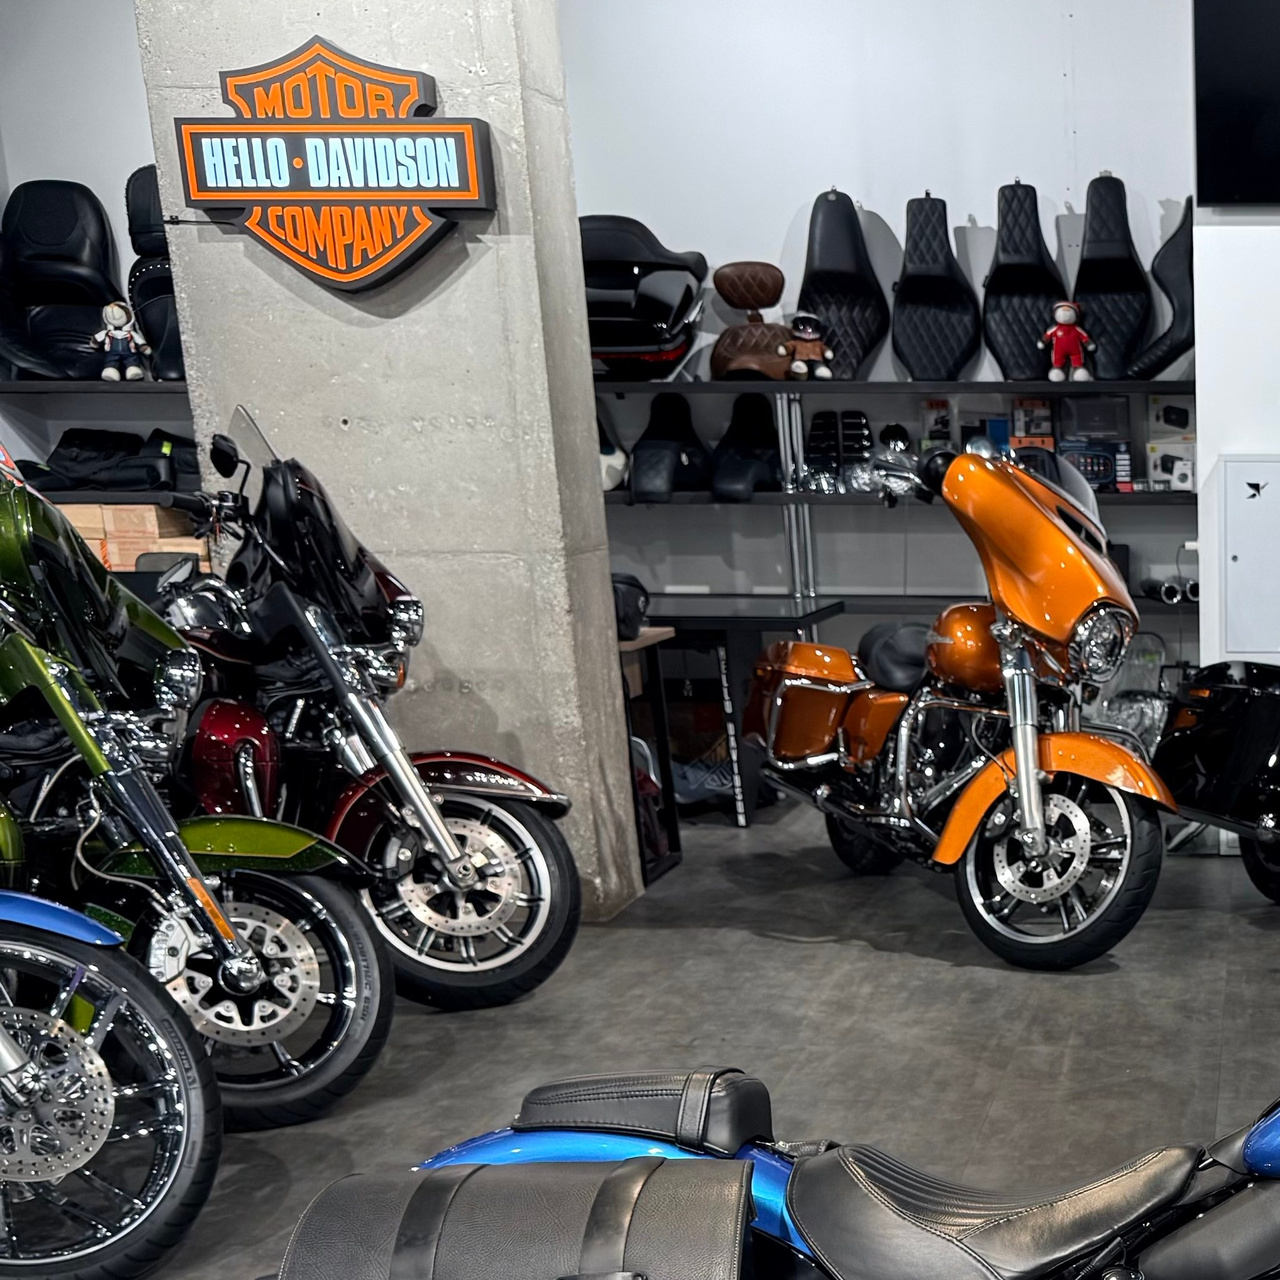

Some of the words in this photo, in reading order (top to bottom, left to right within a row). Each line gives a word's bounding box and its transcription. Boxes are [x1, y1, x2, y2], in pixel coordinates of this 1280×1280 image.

[253, 60, 396, 119] MOTOR
[201, 137, 291, 188] HELLO
[304, 137, 460, 188] DAVIDSON
[267, 205, 408, 270] COMPANY
